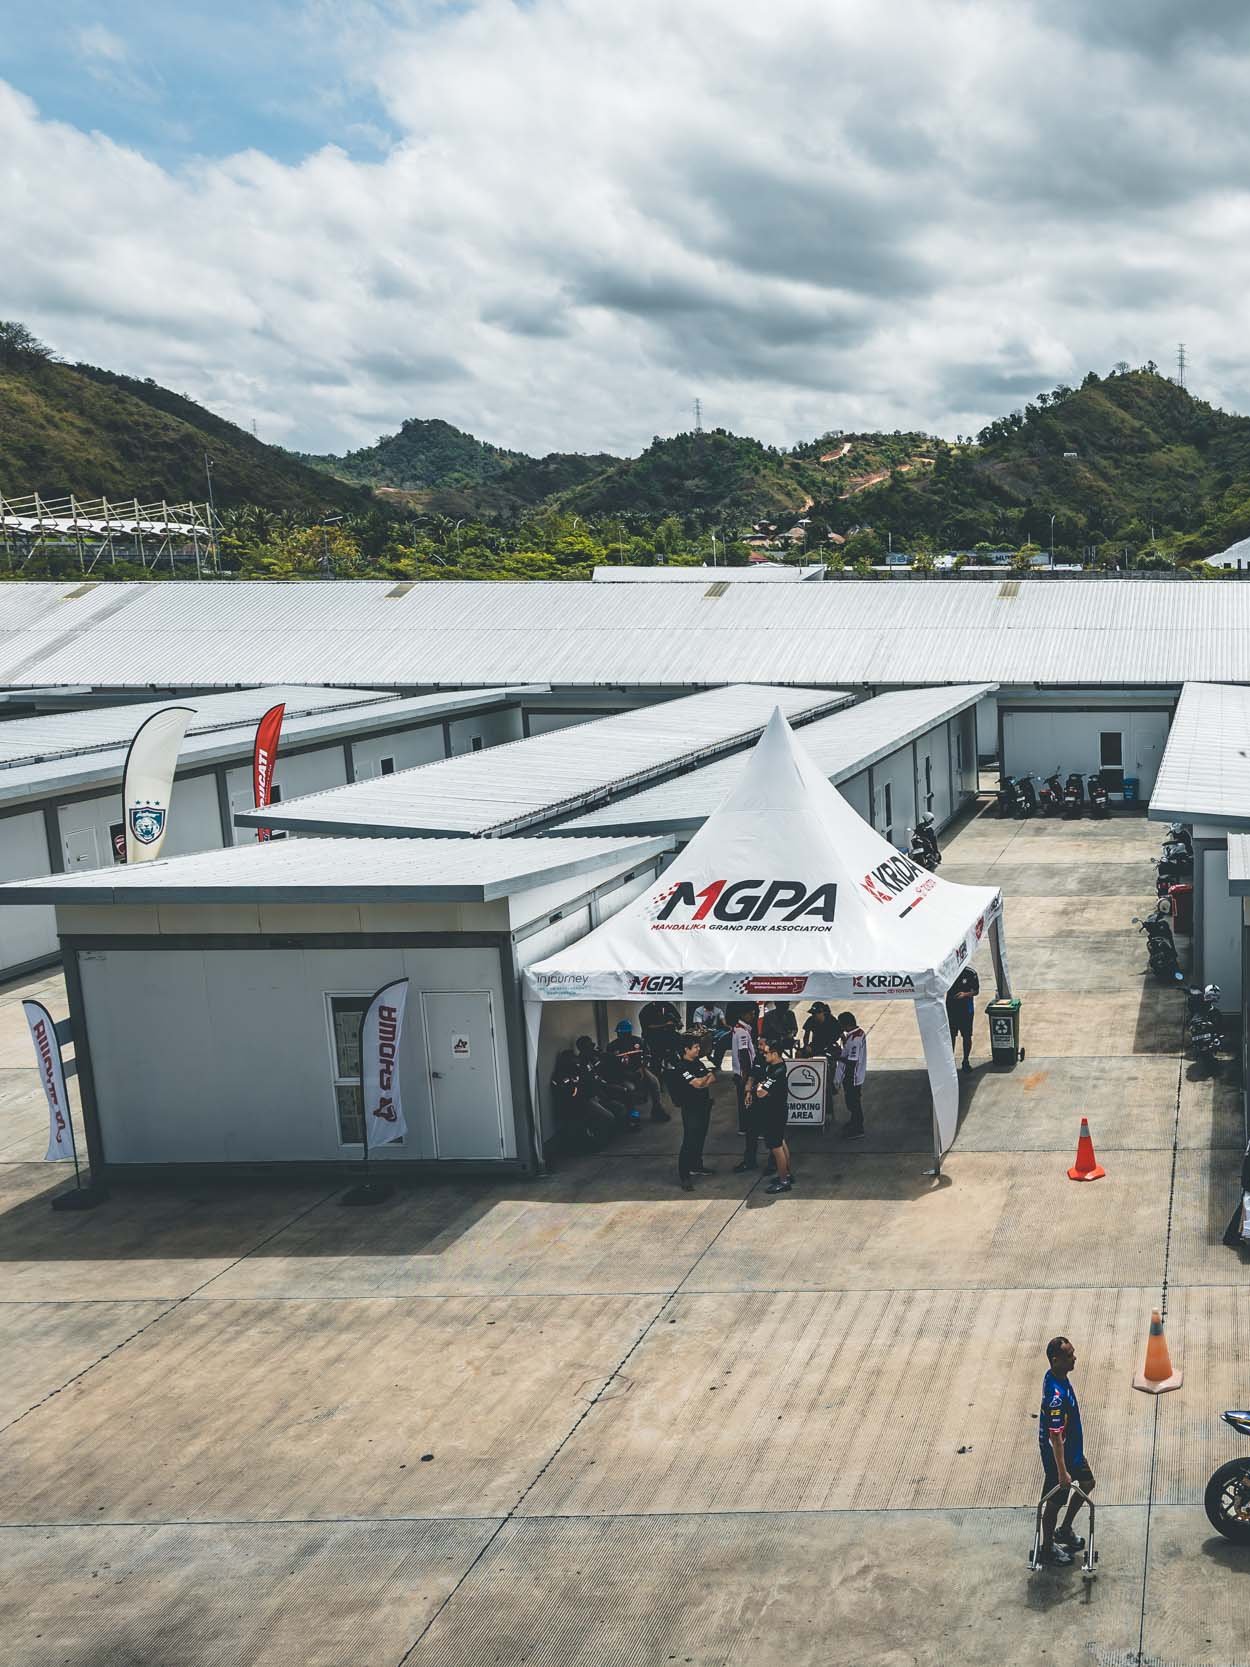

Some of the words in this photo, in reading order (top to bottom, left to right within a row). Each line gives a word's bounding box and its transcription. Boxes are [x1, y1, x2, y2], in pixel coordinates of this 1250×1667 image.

[871, 852, 923, 896] KRIDA
[657, 880, 837, 922] MGPA
[537, 974, 589, 987] injourney
[629, 976, 683, 991] MGPA
[866, 975, 915, 987] KRIDA
[378, 1005, 397, 1091] SHOWA
